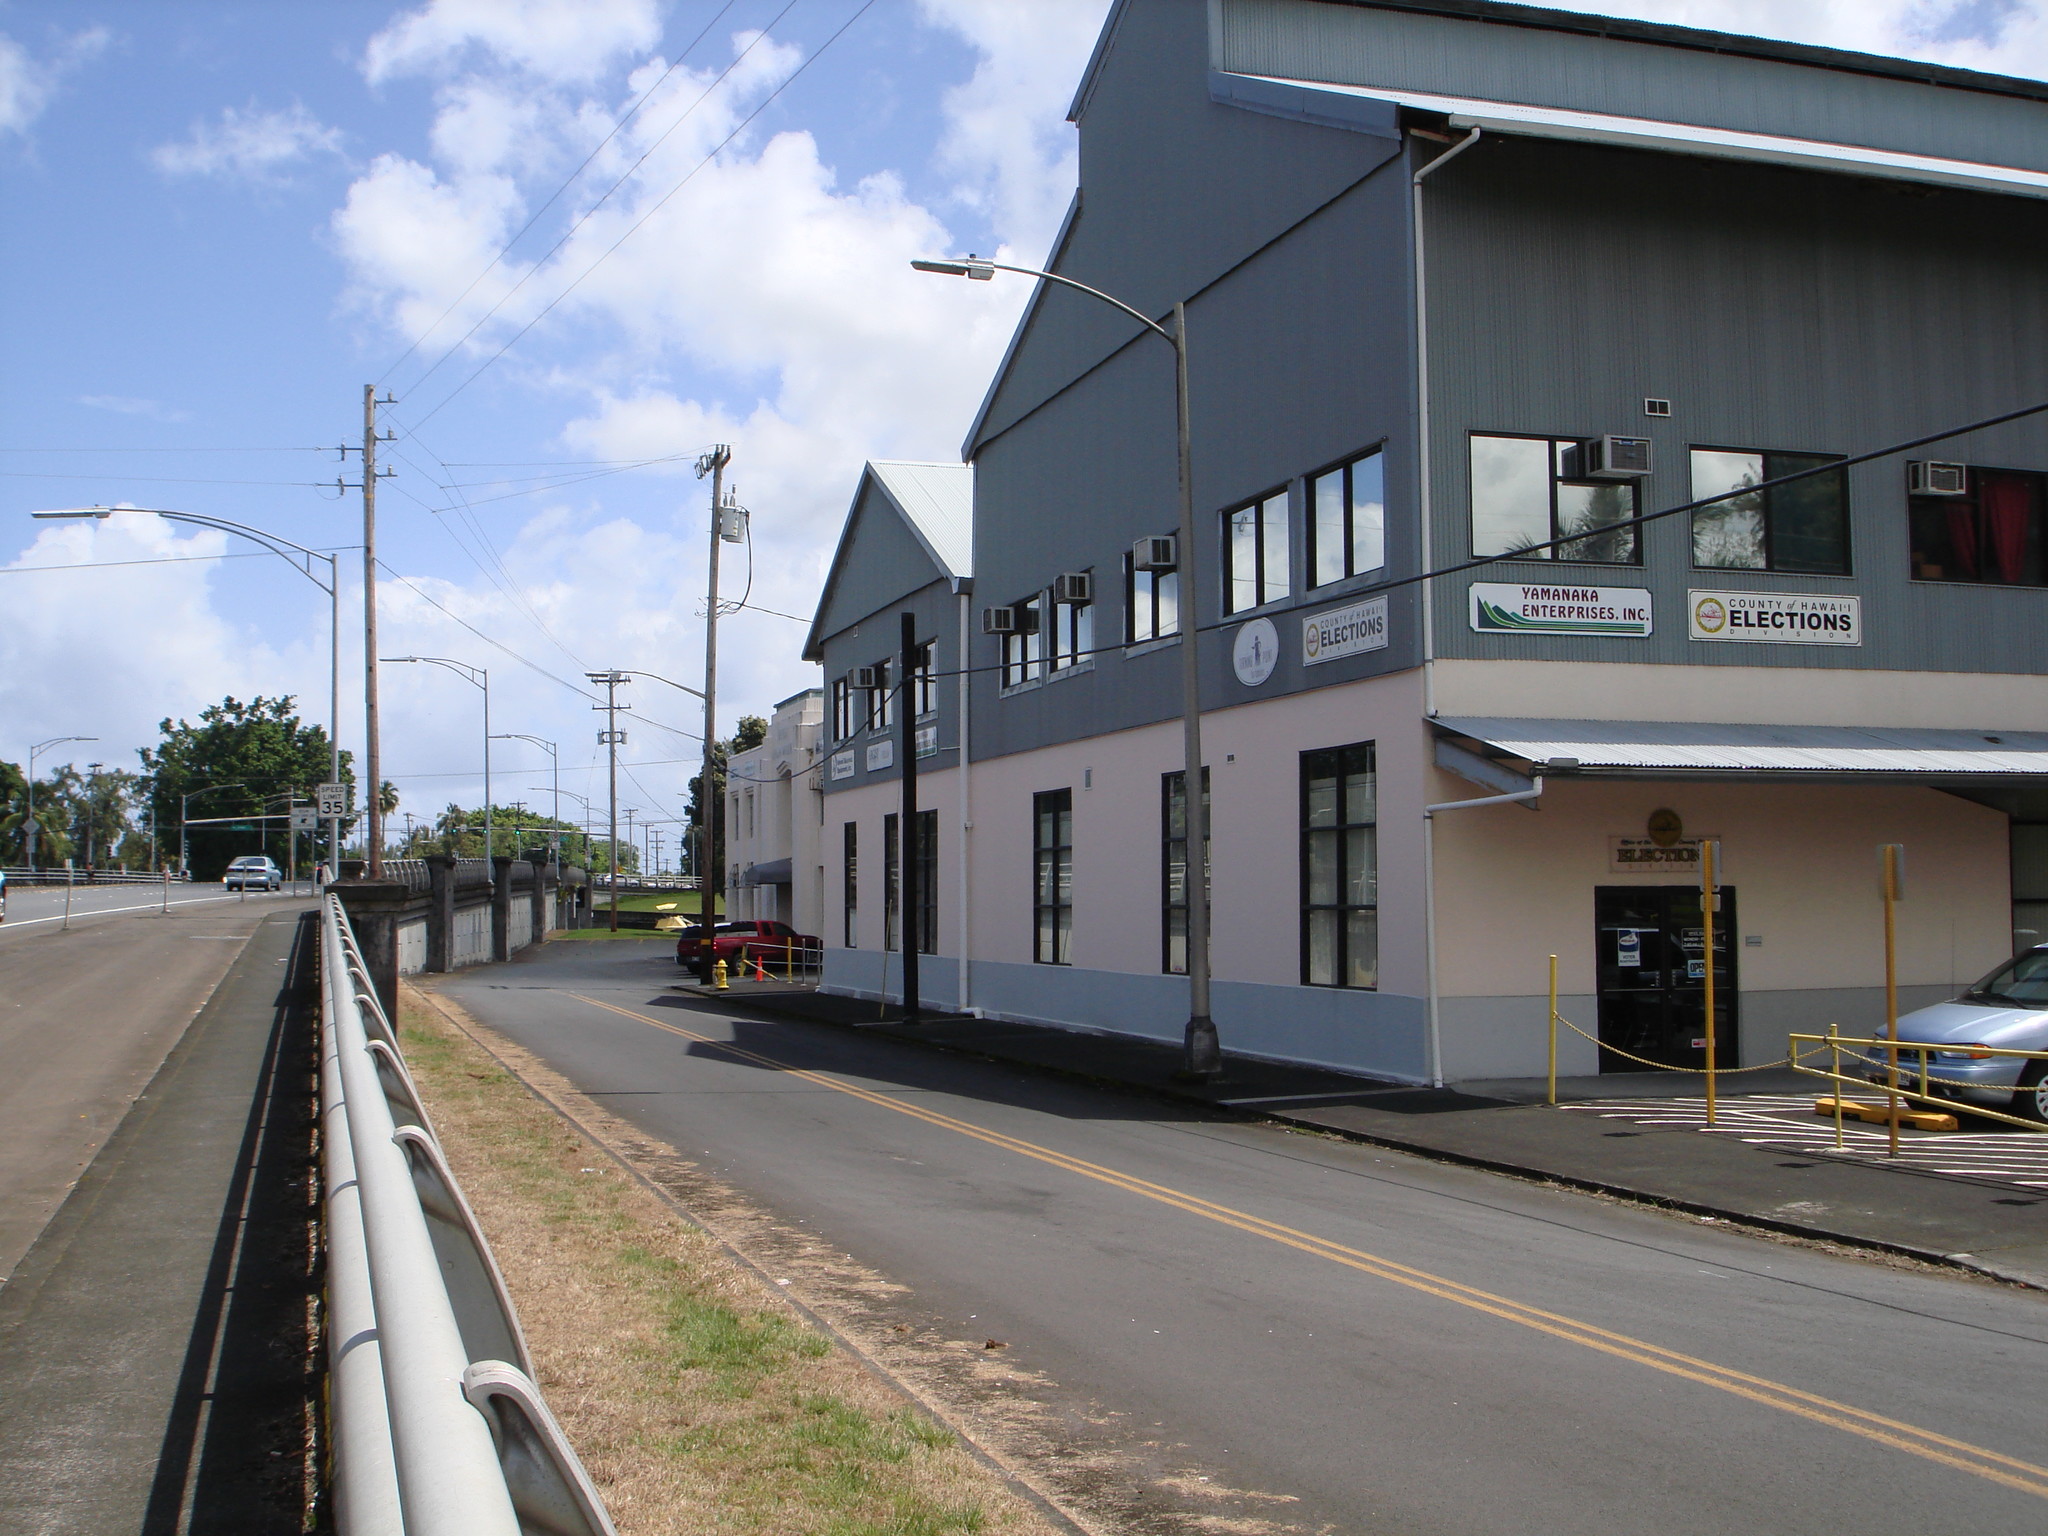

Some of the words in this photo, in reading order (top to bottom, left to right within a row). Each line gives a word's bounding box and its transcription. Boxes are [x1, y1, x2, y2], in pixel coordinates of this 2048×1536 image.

[1522, 587, 1599, 602] YAMANAKA
[1729, 599, 1782, 610] COUNTY
[1787, 600, 1797, 612] of
[1623, 607, 1650, 621] INC.
[1729, 610, 1852, 632] ELECTIONS
[1320, 615, 1347, 629] COUNTY
[1320, 616, 1384, 648] ELECTIONS
[1730, 629, 1852, 639] DIVISION
[321, 801, 344, 814] 35
